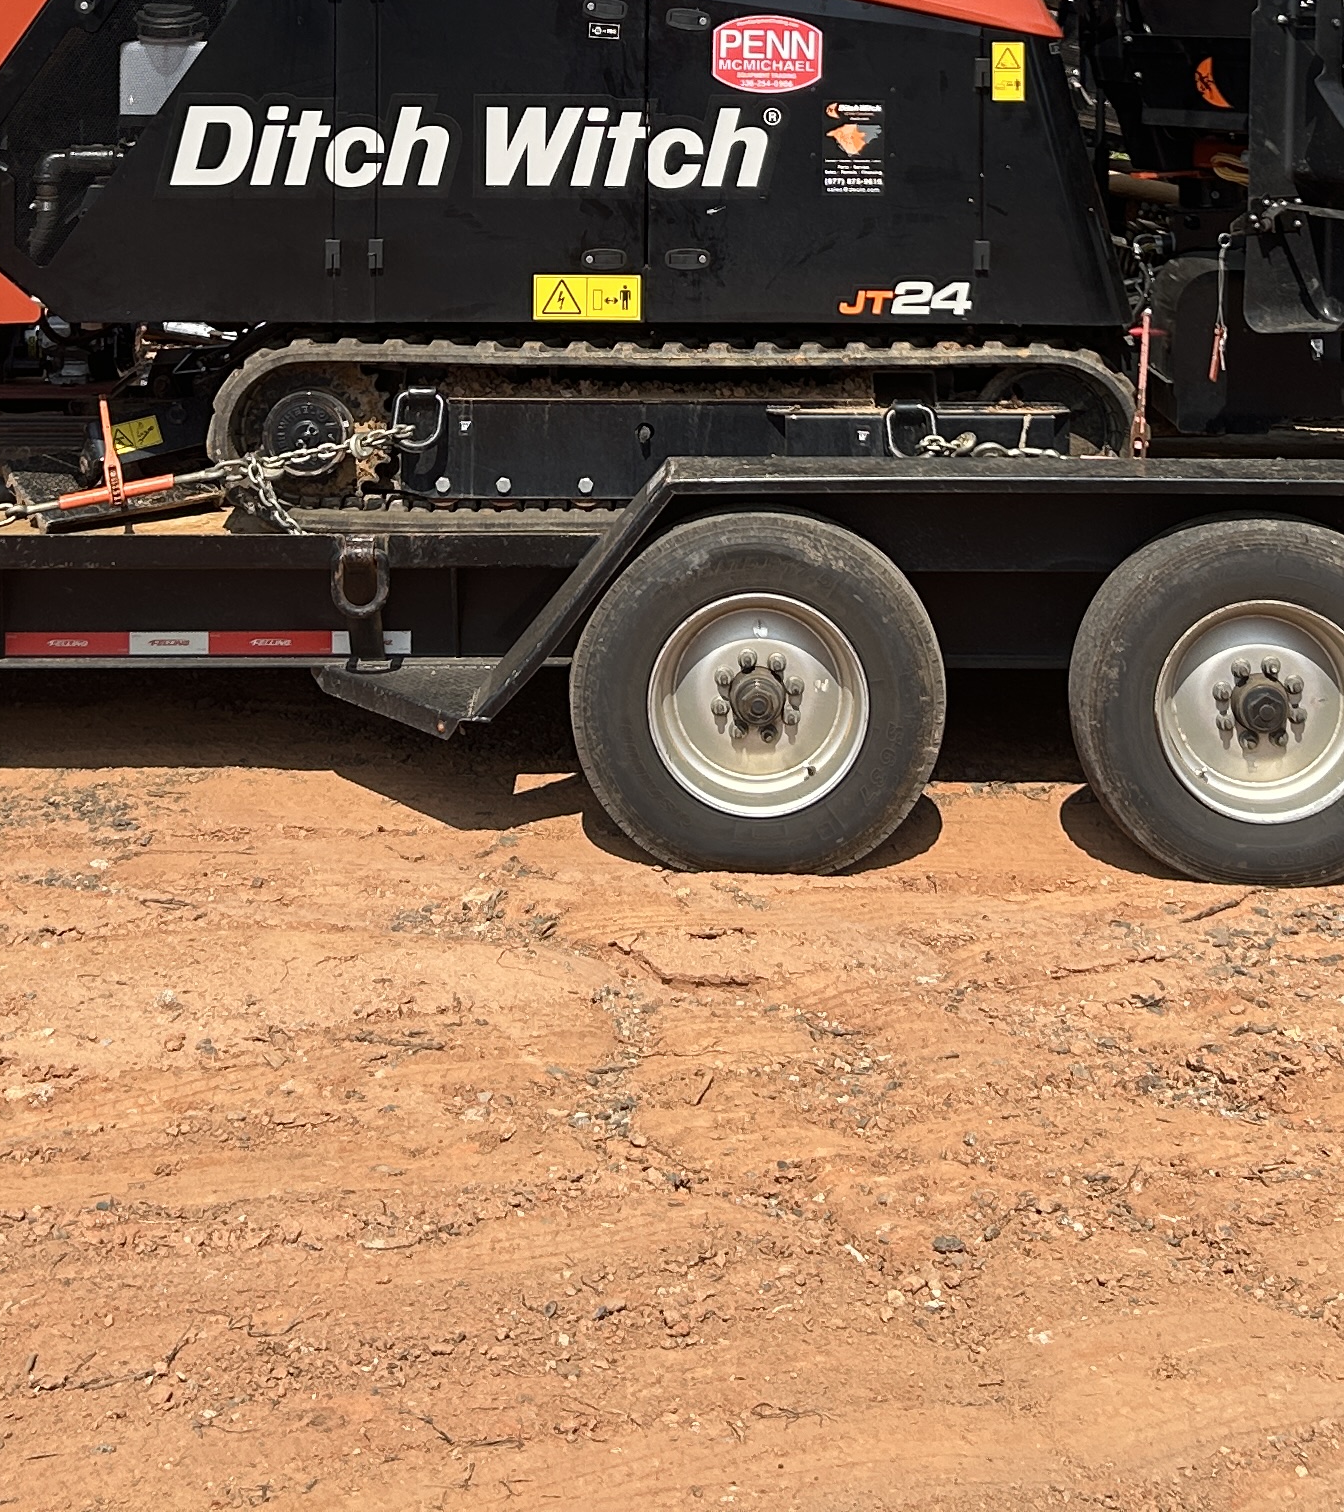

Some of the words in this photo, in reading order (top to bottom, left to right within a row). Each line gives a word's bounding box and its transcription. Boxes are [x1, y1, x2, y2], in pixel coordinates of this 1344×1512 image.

[719, 29, 815, 60] PENN
[718, 59, 816, 72] MCMICHAEL
[168, 105, 451, 188] Ditch
[838, 281, 973, 316] JT24
